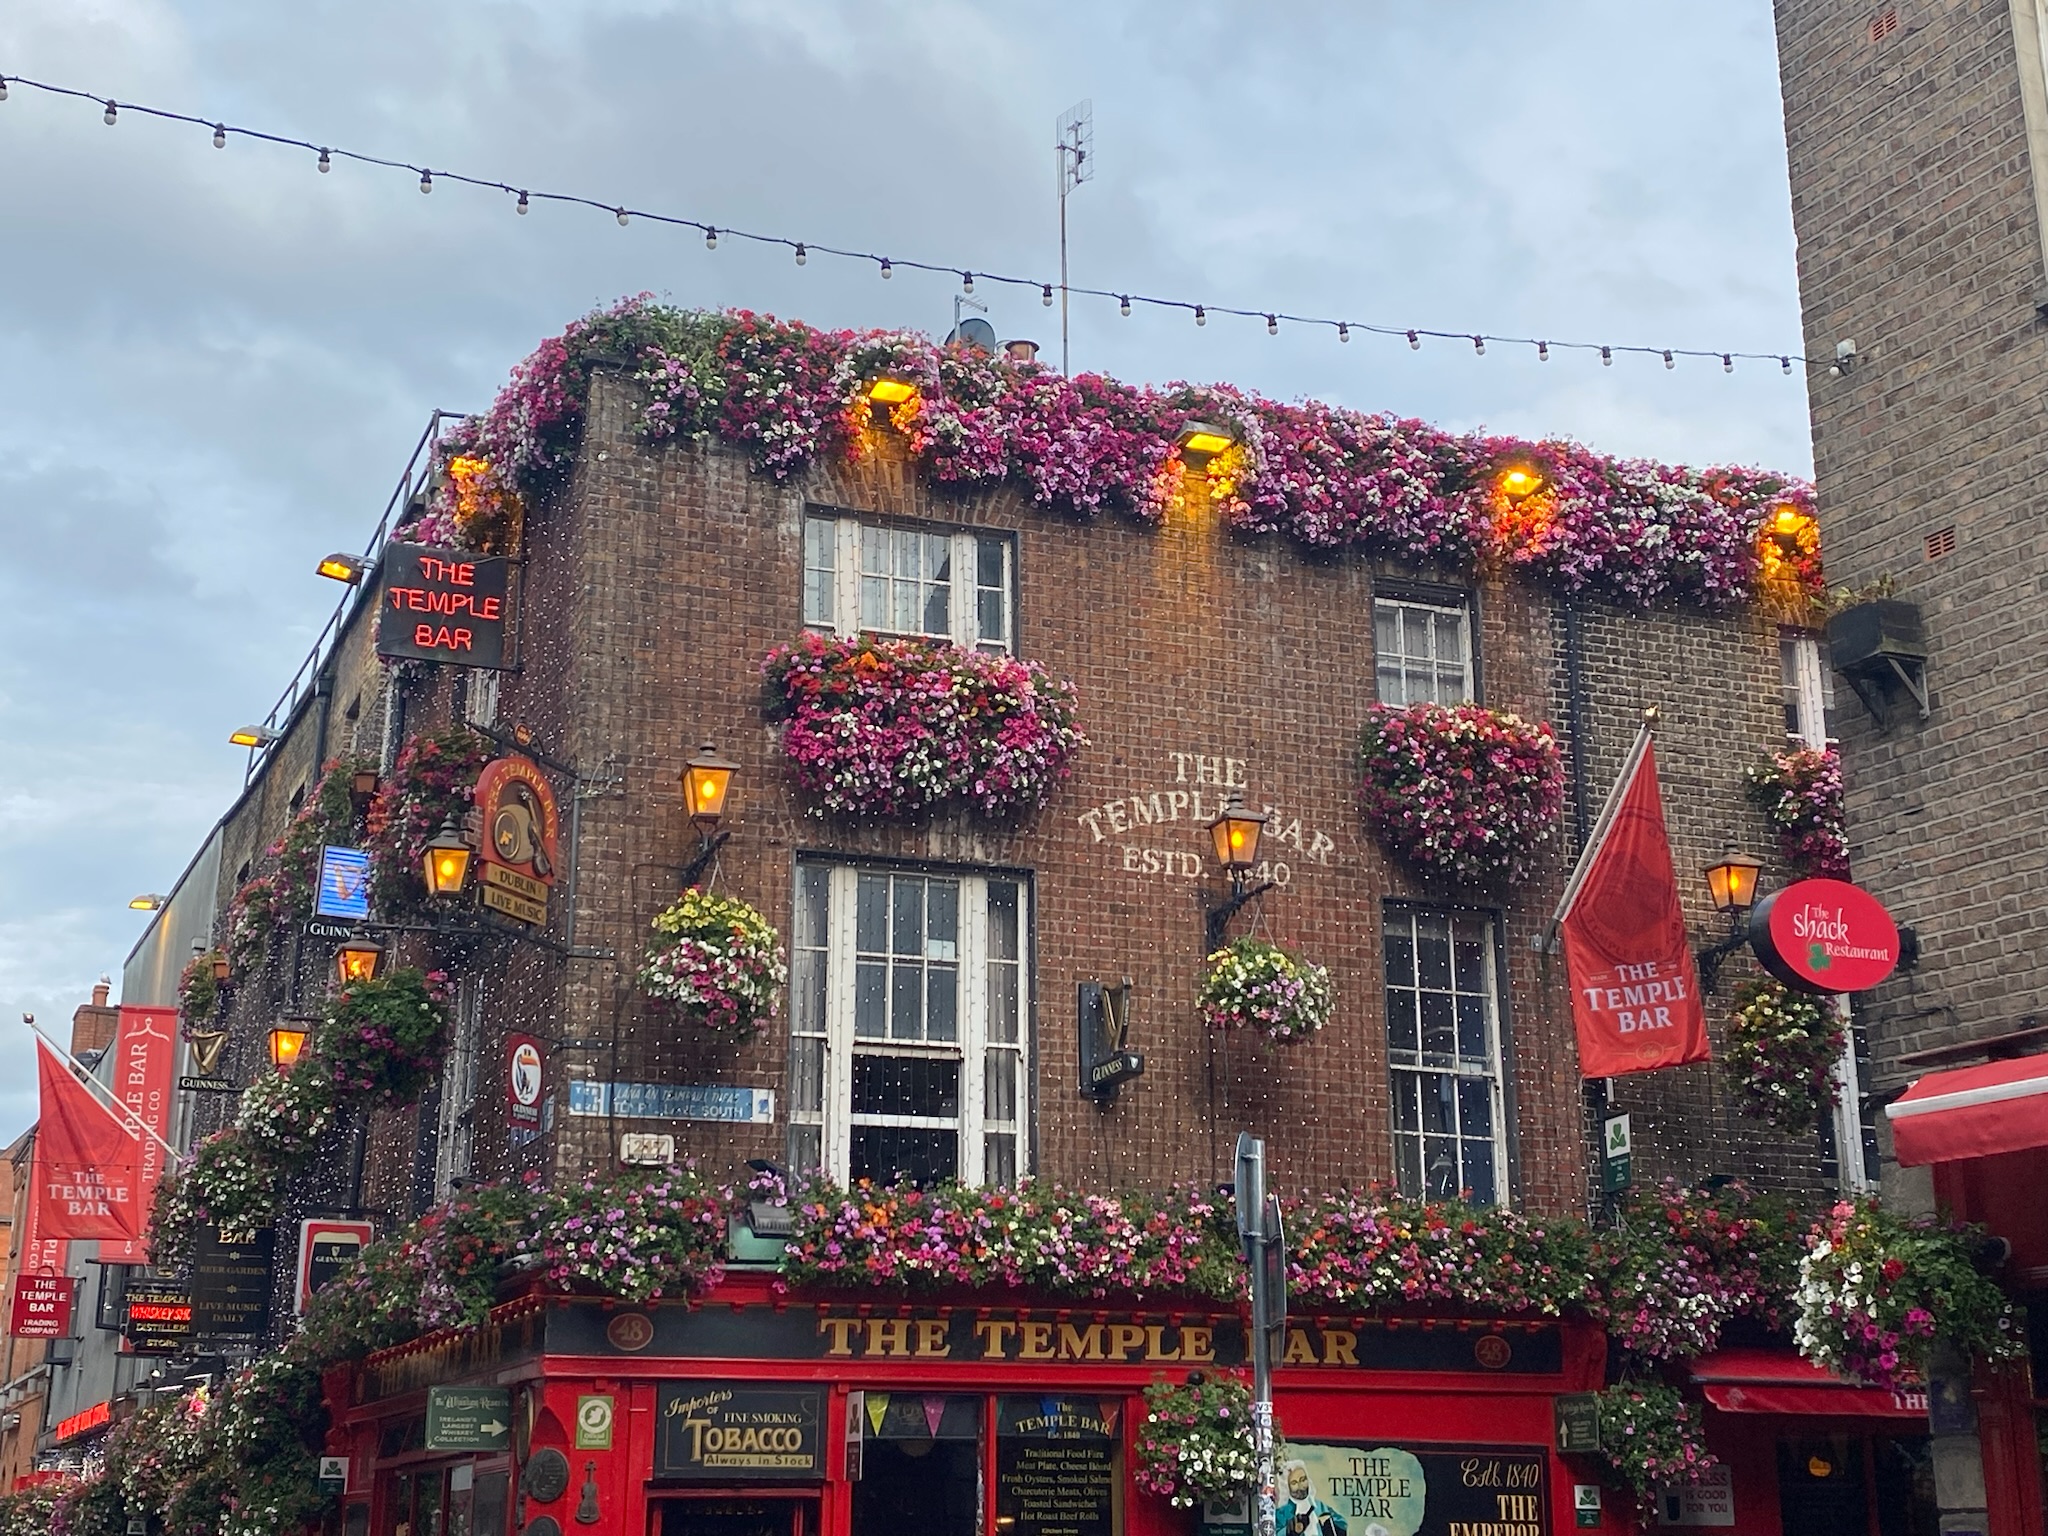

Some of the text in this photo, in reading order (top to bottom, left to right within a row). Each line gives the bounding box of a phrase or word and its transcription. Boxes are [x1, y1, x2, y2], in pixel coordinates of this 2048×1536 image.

[420, 557, 475, 586] THE
[389, 587, 500, 620] TEMPLE
[415, 624, 472, 651] BAR
[1169, 752, 1249, 788] THE
[502, 763, 546, 796] TEMPLE
[543, 799, 554, 839] BAR
[1122, 846, 1209, 879] ESTD.
[500, 870, 537, 895] DUBLIN
[491, 891, 543, 921] LIVE MUSIC
[1811, 903, 1829, 920] The
[1793, 904, 1850, 945] Shack
[1825, 942, 1889, 962] Restaurant
[1615, 962, 1659, 983] THE
[1583, 976, 1687, 1012] TEMPLE
[1617, 1007, 1673, 1034] BAR
[128, 1043, 148, 1086] BAR
[181, 1077, 229, 1089] GUINNESS
[702, 1105, 744, 1118] SOUTH
[73, 1171, 104, 1185] THE
[48, 1184, 128, 1202] TEMPLE
[67, 1202, 111, 1216] BAR
[226, 1266, 267, 1275] GARDEN
[35, 1279, 57, 1290] THE
[21, 1291, 67, 1301] TEMPLE
[125, 1293, 144, 1303] THE
[29, 1302, 54, 1312] BAR
[199, 1302, 224, 1311] LIVE
[24, 1319, 58, 1327] TRADING
[212, 1314, 246, 1323] DAILY
[20, 1327, 60, 1335] COMPANY
[616, 1319, 642, 1342] 48
[820, 1318, 1360, 1365] THE TEMPLE AR
[664, 1389, 733, 1419] Importers
[707, 1406, 719, 1415] OF
[1056, 1402, 1073, 1412] The
[724, 1412, 802, 1424] FINE SMOKING
[1015, 1415, 1110, 1436] TEMPLE BAR
[434, 1435, 480, 1443] COLLECTION
[705, 1454, 752, 1467] Always
[775, 1455, 812, 1466] Stock
[1024, 1448, 1065, 1459] Traditional
[1066, 1449, 1086, 1459] Food
[1016, 1461, 1036, 1471] Meat
[1060, 1462, 1088, 1471] Cheese
[1349, 1457, 1392, 1478] THE
[1057, 1474, 1088, 1484] Smoked
[1506, 1463, 1539, 1489] 1840
[1011, 1486, 1055, 1496] Charcuterie
[1328, 1478, 1412, 1498] TEMPLE
[1697, 1490, 1727, 1500] GOOD
[1022, 1498, 1098, 1509] Toasted Sandwiches
[1351, 1498, 1394, 1519] BAR
[1497, 1494, 1538, 1521] THE
[1686, 1503, 1728, 1513] FOR YOU
[1020, 1511, 1035, 1521] Hot
[1036, 1511, 1059, 1521] Roast
[1079, 1511, 1099, 1521] Rolls
